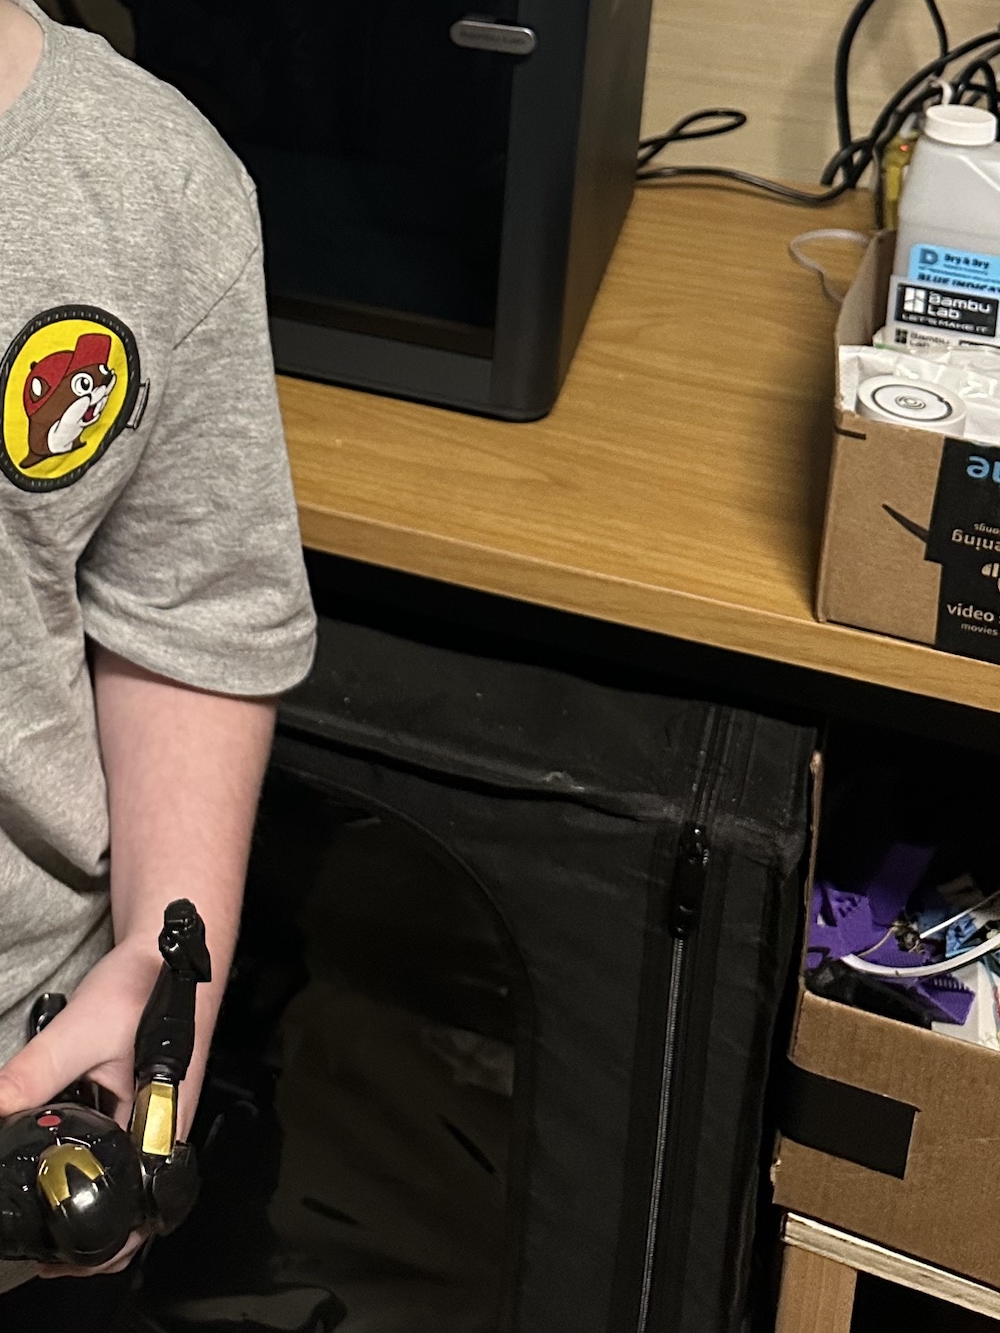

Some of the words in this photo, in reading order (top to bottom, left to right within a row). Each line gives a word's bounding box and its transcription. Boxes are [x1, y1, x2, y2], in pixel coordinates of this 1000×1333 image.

[944, 253, 961, 265] Dry
[972, 258, 989, 269] Dry
[951, 279, 1000, 293] INDICA
[928, 292, 991, 314] Bambu
[927, 304, 961, 320] Lab
[946, 603, 994, 622] video
[960, 623, 998, 636] movies
